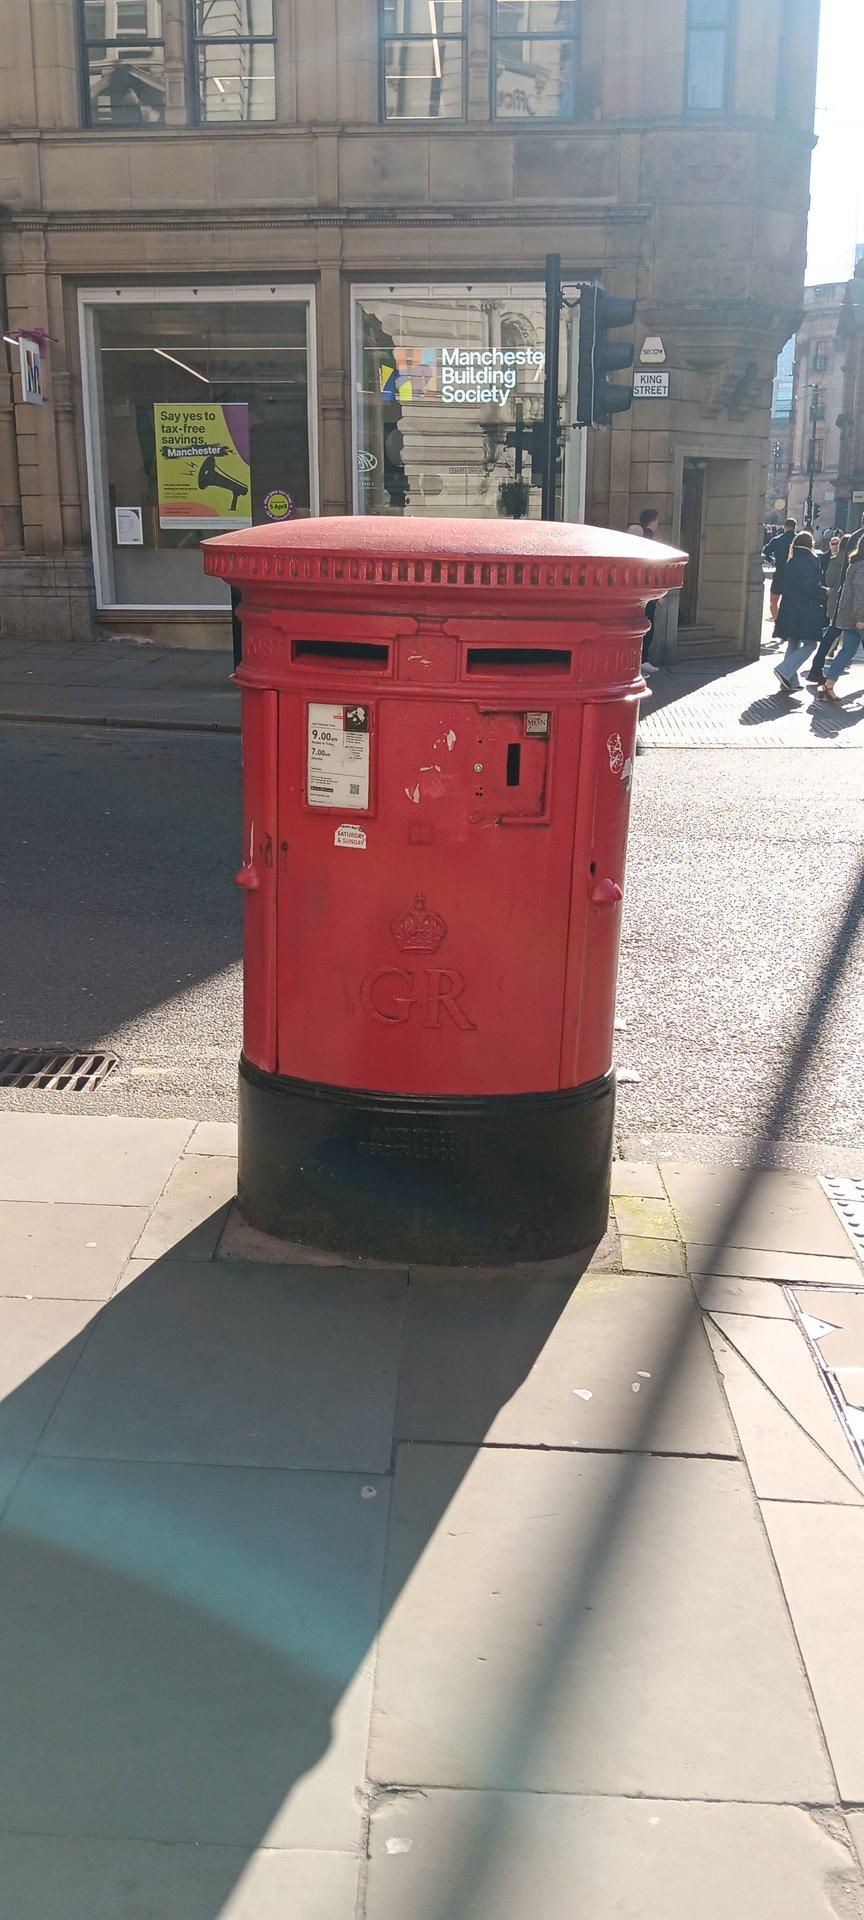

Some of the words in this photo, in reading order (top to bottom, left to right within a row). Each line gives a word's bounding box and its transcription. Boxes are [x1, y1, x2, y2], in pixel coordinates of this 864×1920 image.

[442, 348, 545, 366] Mancheste
[442, 367, 516, 388] Building
[640, 375, 662, 384] KING
[441, 385, 511, 407] Society
[634, 386, 668, 395] STREET
[160, 411, 182, 423] Say
[183, 413, 205, 423] yes
[205, 411, 216, 421] to
[161, 424, 205, 433] tax-free
[167, 446, 222, 457] Manchester
[274, 502, 288, 511] April
[337, 831, 365, 839] SATURDAY
[360, 965, 478, 1031] GR
